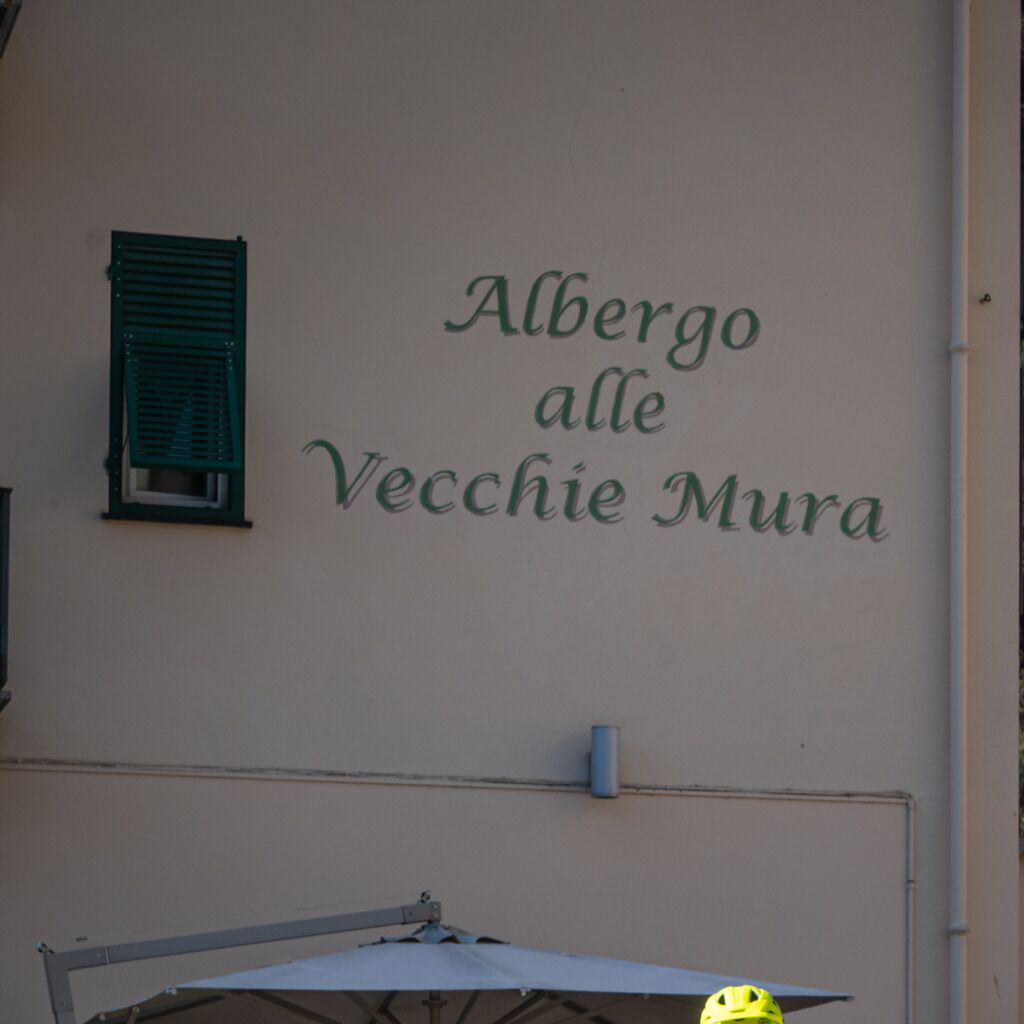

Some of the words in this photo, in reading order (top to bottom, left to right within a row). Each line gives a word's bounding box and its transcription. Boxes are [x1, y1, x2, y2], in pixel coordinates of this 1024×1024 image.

[444, 270, 760, 371] Albergo
[534, 366, 666, 434] alle
[301, 438, 626, 524] Vecchie
[651, 470, 889, 543] Mura
